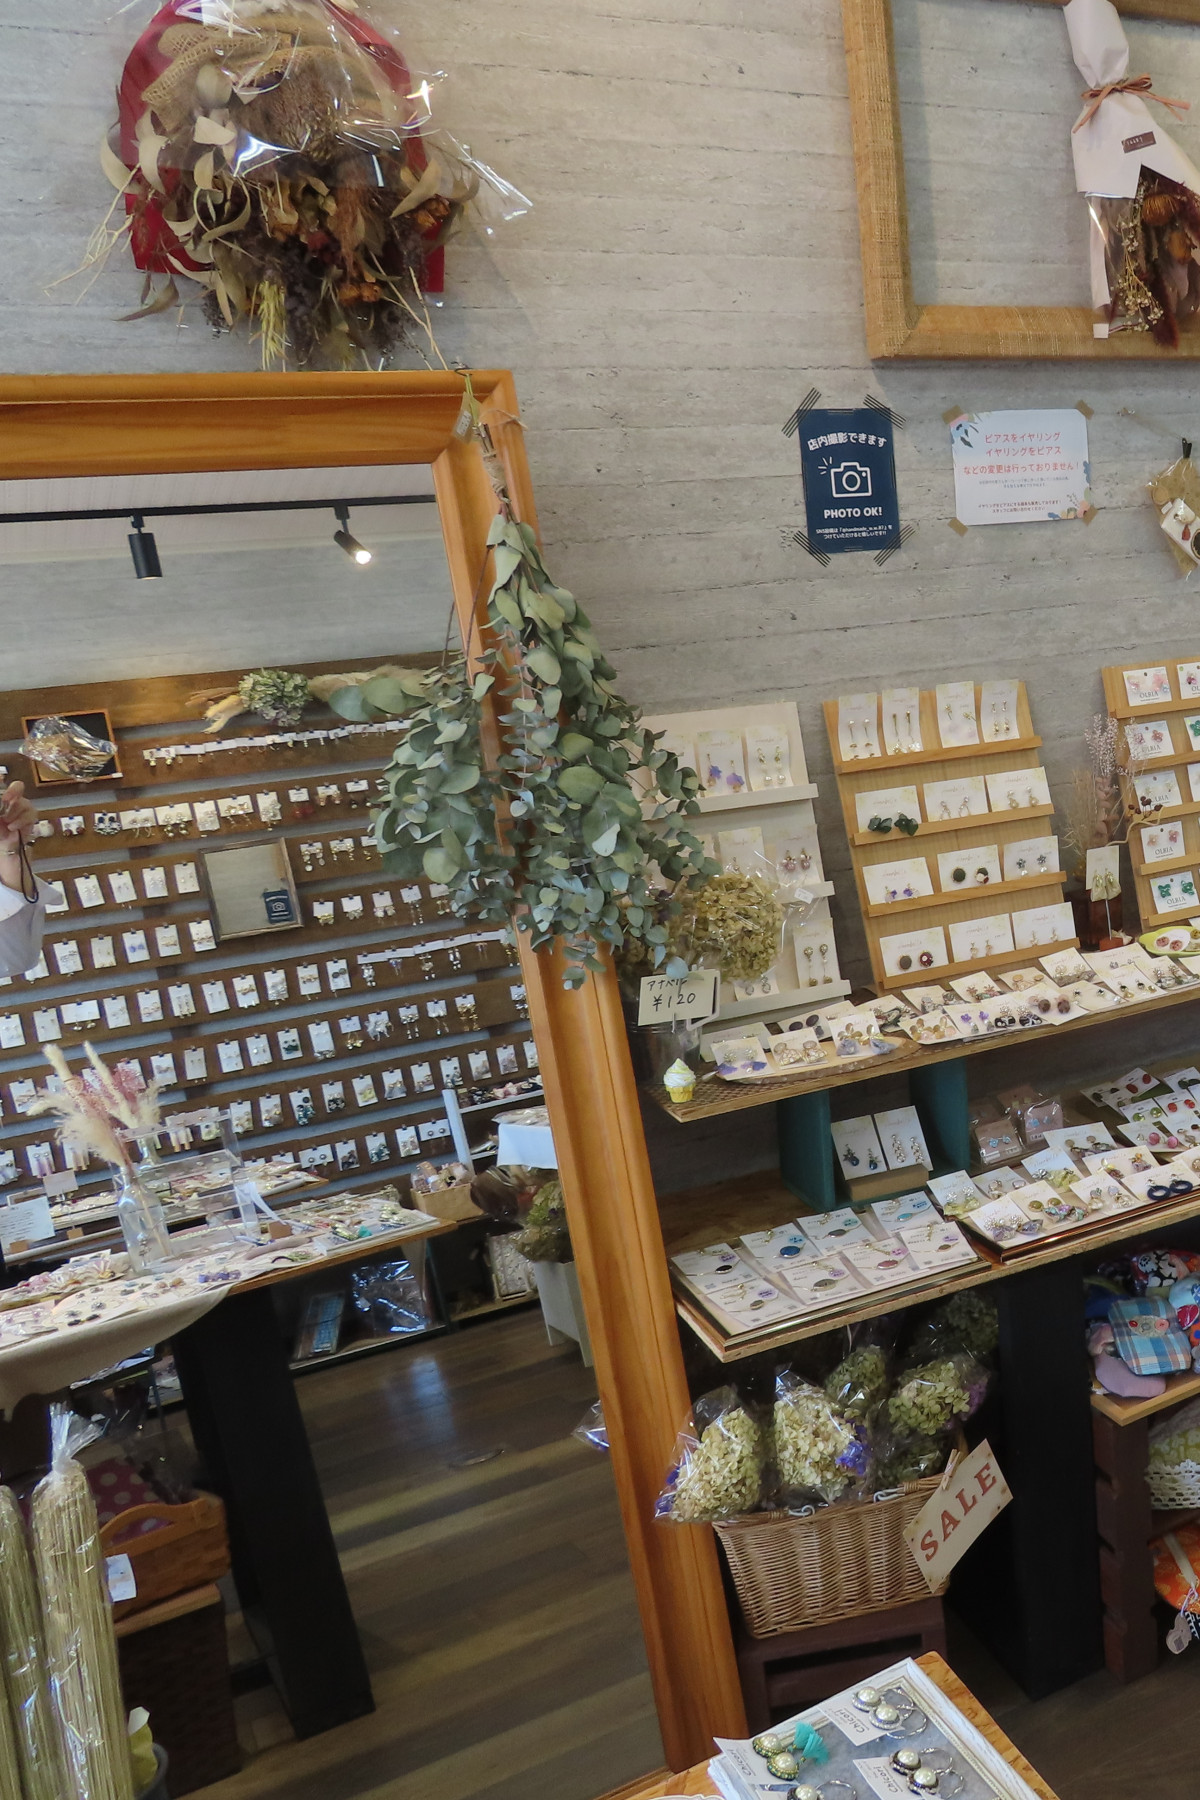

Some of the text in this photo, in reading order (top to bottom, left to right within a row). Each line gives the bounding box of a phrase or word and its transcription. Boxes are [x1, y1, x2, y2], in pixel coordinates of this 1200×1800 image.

[807, 432, 887, 451] 店内撮影できます
[985, 432, 1061, 444] ピアスをイヤリング
[986, 446, 1061, 456] イヤリングをピアス
[824, 506, 882, 519] PHOTO OK!
[652, 992, 696, 1012] ¥120
[920, 1462, 997, 1562] SALE
[838, 1708, 864, 1733] Chicori
[727, 1750, 751, 1777] Chicori
[874, 1766, 898, 1794] Chicori
